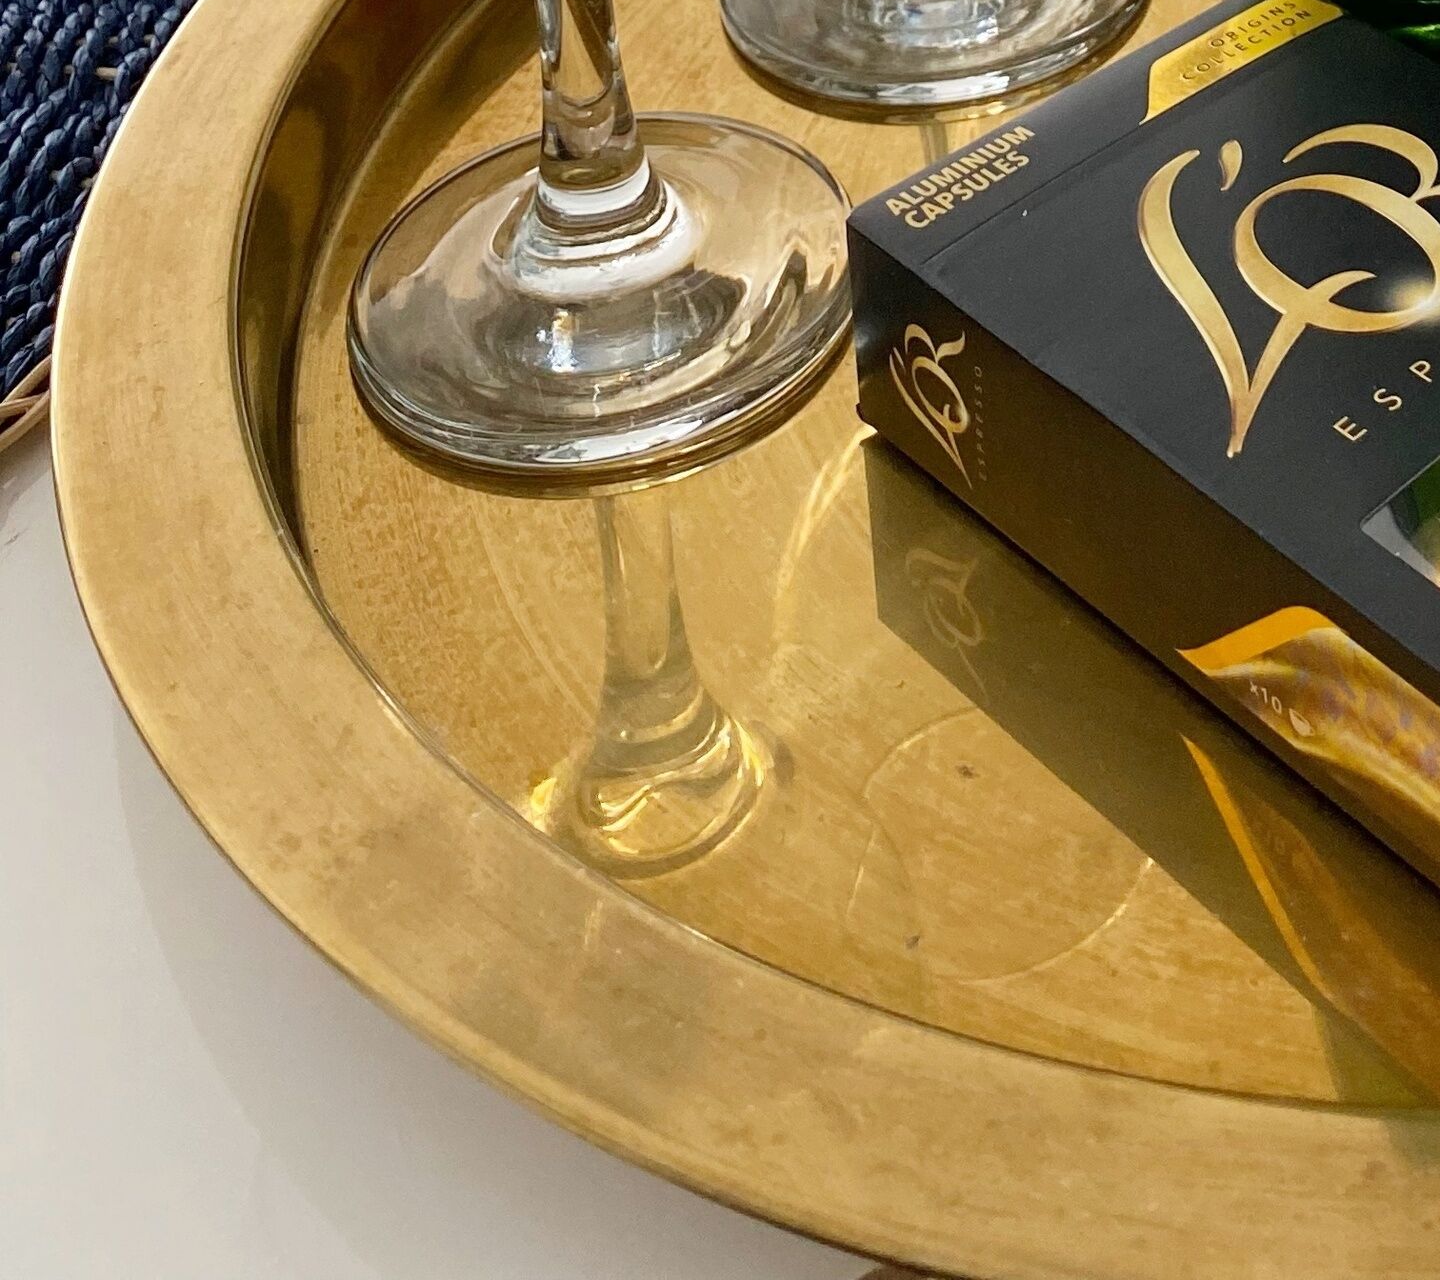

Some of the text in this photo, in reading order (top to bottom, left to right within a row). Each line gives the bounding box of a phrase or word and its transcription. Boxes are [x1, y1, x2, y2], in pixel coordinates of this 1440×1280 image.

[1181, 10, 1312, 81] COLLECTION
[1210, 1, 1297, 48] ORIGINS
[885, 125, 1036, 217] ALUMINIUM
[904, 150, 1030, 229] CAPSULES
